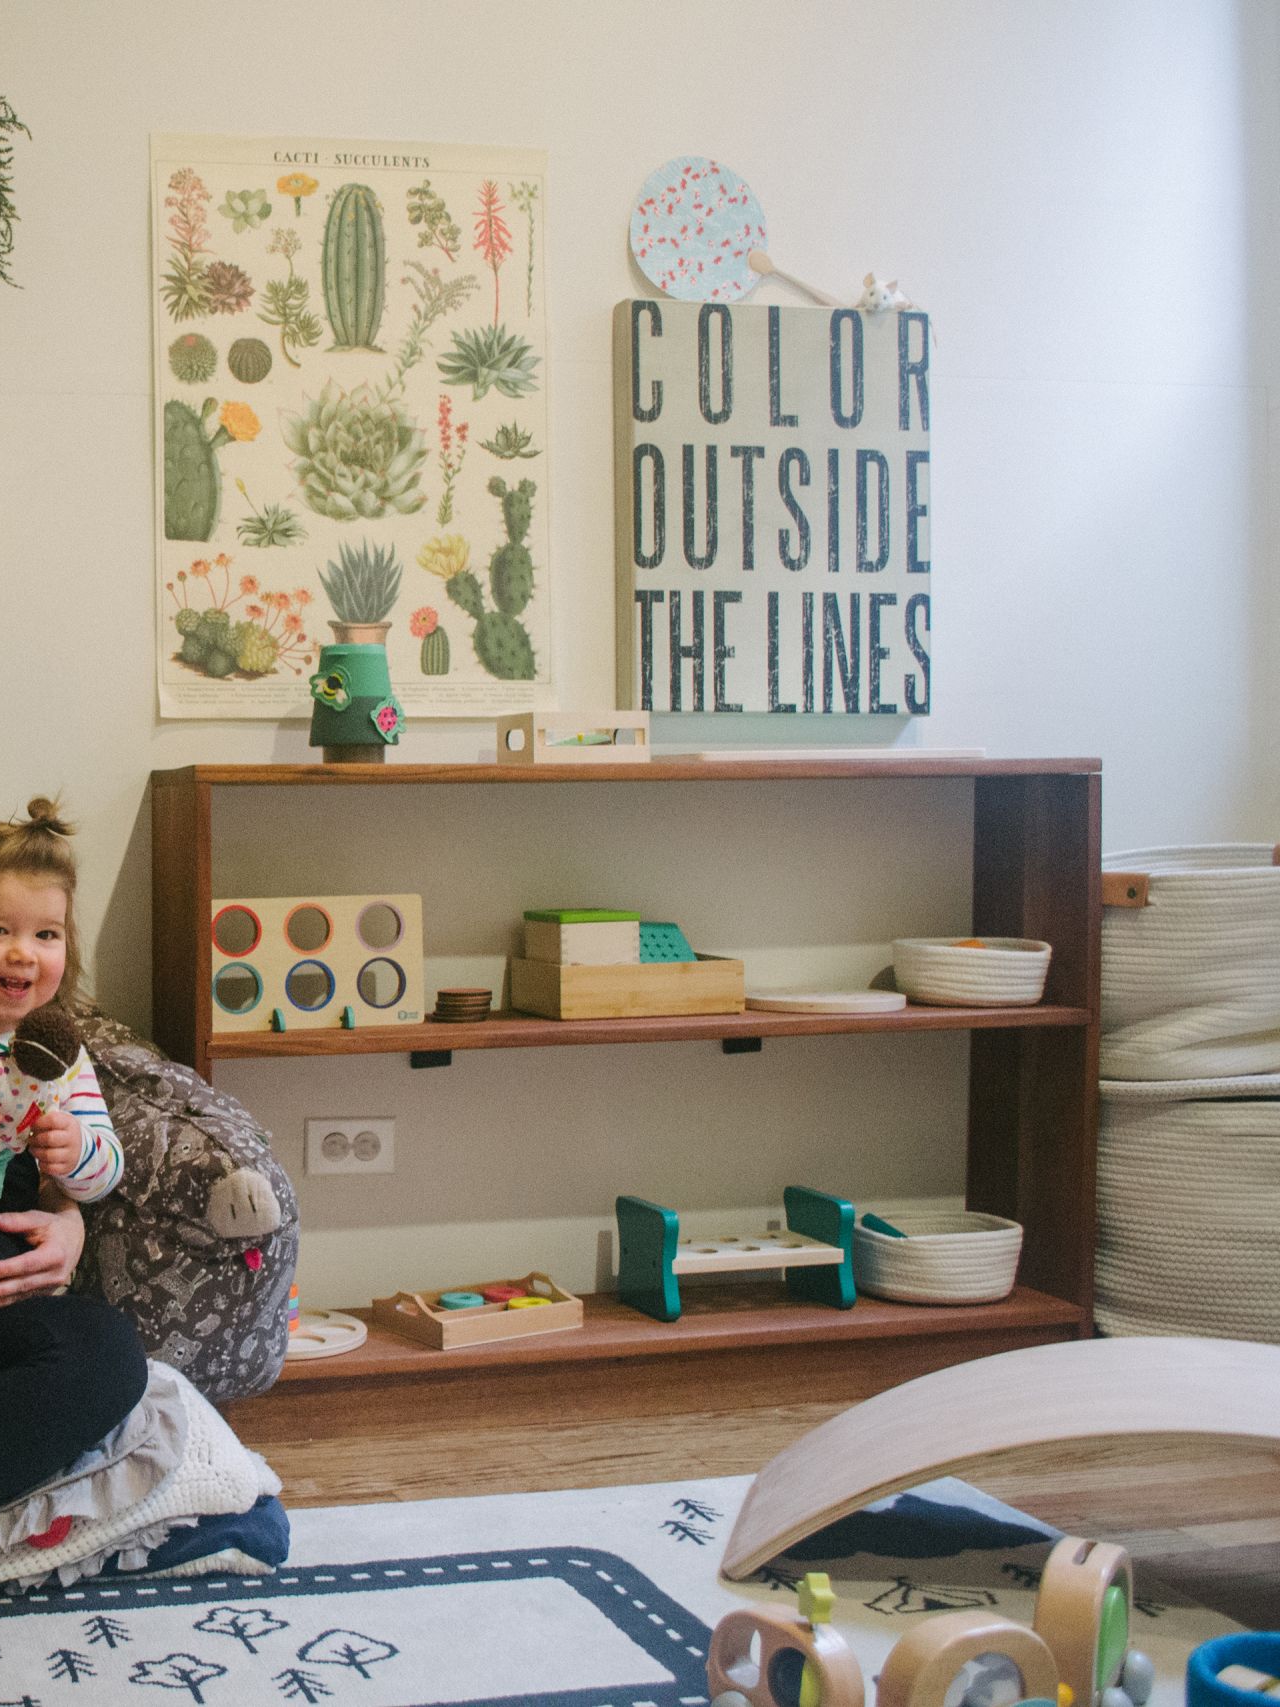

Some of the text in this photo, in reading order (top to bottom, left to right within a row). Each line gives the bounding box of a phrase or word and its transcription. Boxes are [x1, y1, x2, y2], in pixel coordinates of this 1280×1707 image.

[273, 151, 430, 168] CACTI SUCCULENTS
[631, 300, 930, 430] COLOR
[632, 443, 930, 574] OUTSIDE
[634, 589, 930, 715] THE LINES
